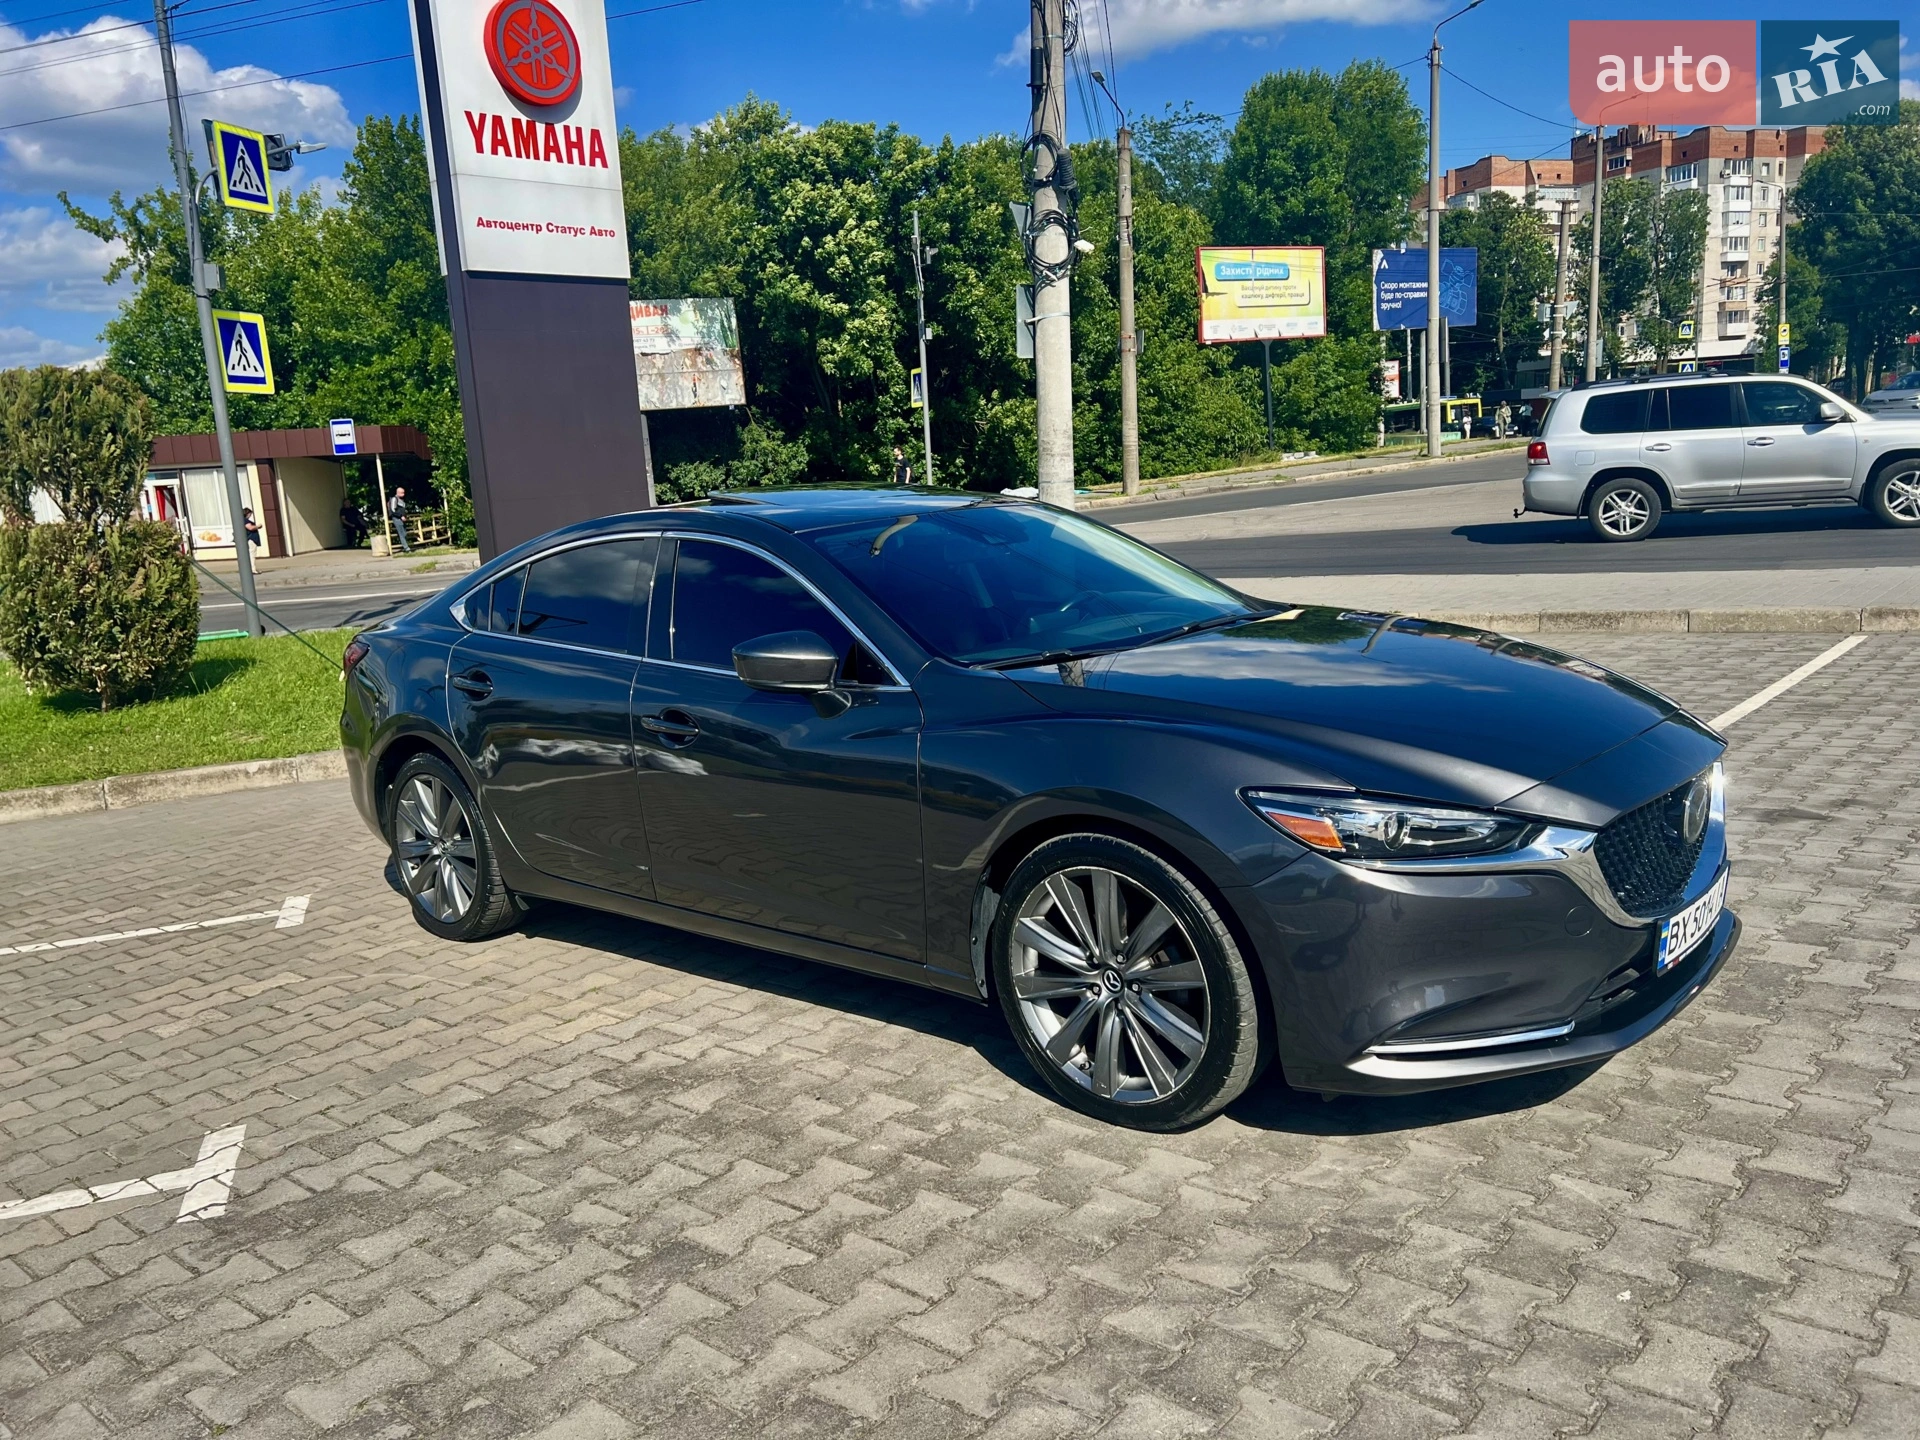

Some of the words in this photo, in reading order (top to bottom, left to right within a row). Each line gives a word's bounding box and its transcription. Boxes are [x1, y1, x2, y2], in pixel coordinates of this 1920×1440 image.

[464, 110, 609, 169] YAMAHA
[476, 216, 543, 234] Автоцентр
[546, 222, 586, 237] Статус
[589, 226, 616, 238] Авто
[1256, 264, 1284, 277] рідних
[1380, 281, 1398, 291] Скоро
[1380, 290, 1394, 301] буде
[1380, 300, 1402, 310] зручно!
